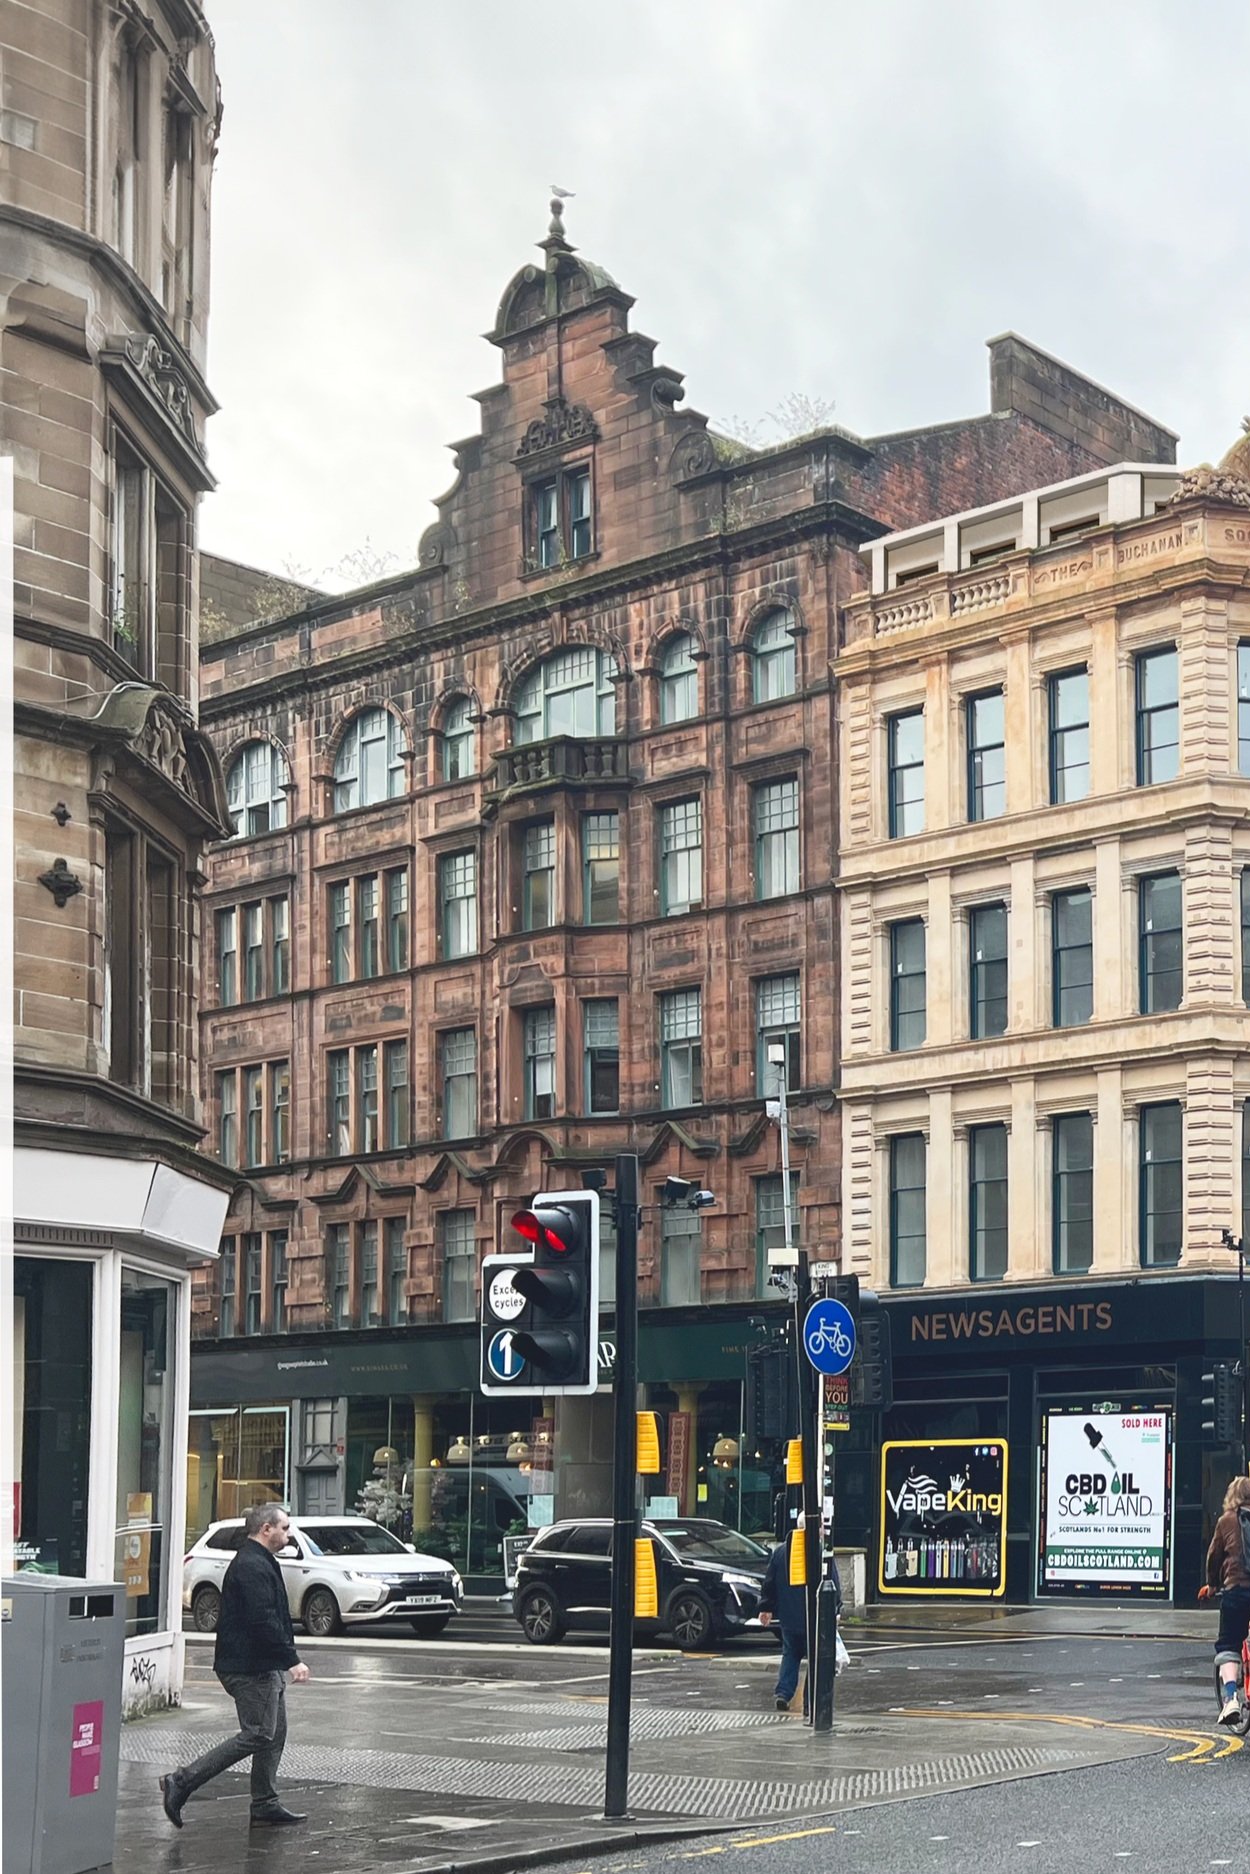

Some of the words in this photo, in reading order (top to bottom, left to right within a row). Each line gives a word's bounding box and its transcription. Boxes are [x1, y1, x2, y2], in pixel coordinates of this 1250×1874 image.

[1050, 563, 1077, 583] THE
[493, 1284, 518, 1295] Exce
[494, 1298, 524, 1309] cycles
[911, 1302, 1113, 1341] NEWSAGENTS
[825, 1392, 849, 1404] YOU
[1121, 1418, 1141, 1428] SOLD
[1143, 1418, 1163, 1428] HERE
[1065, 1473, 1107, 1495] CBD
[886, 1480, 1002, 1516] VapeKing
[1047, 1554, 1160, 1569] CBDOILSCOTLAND.COM
